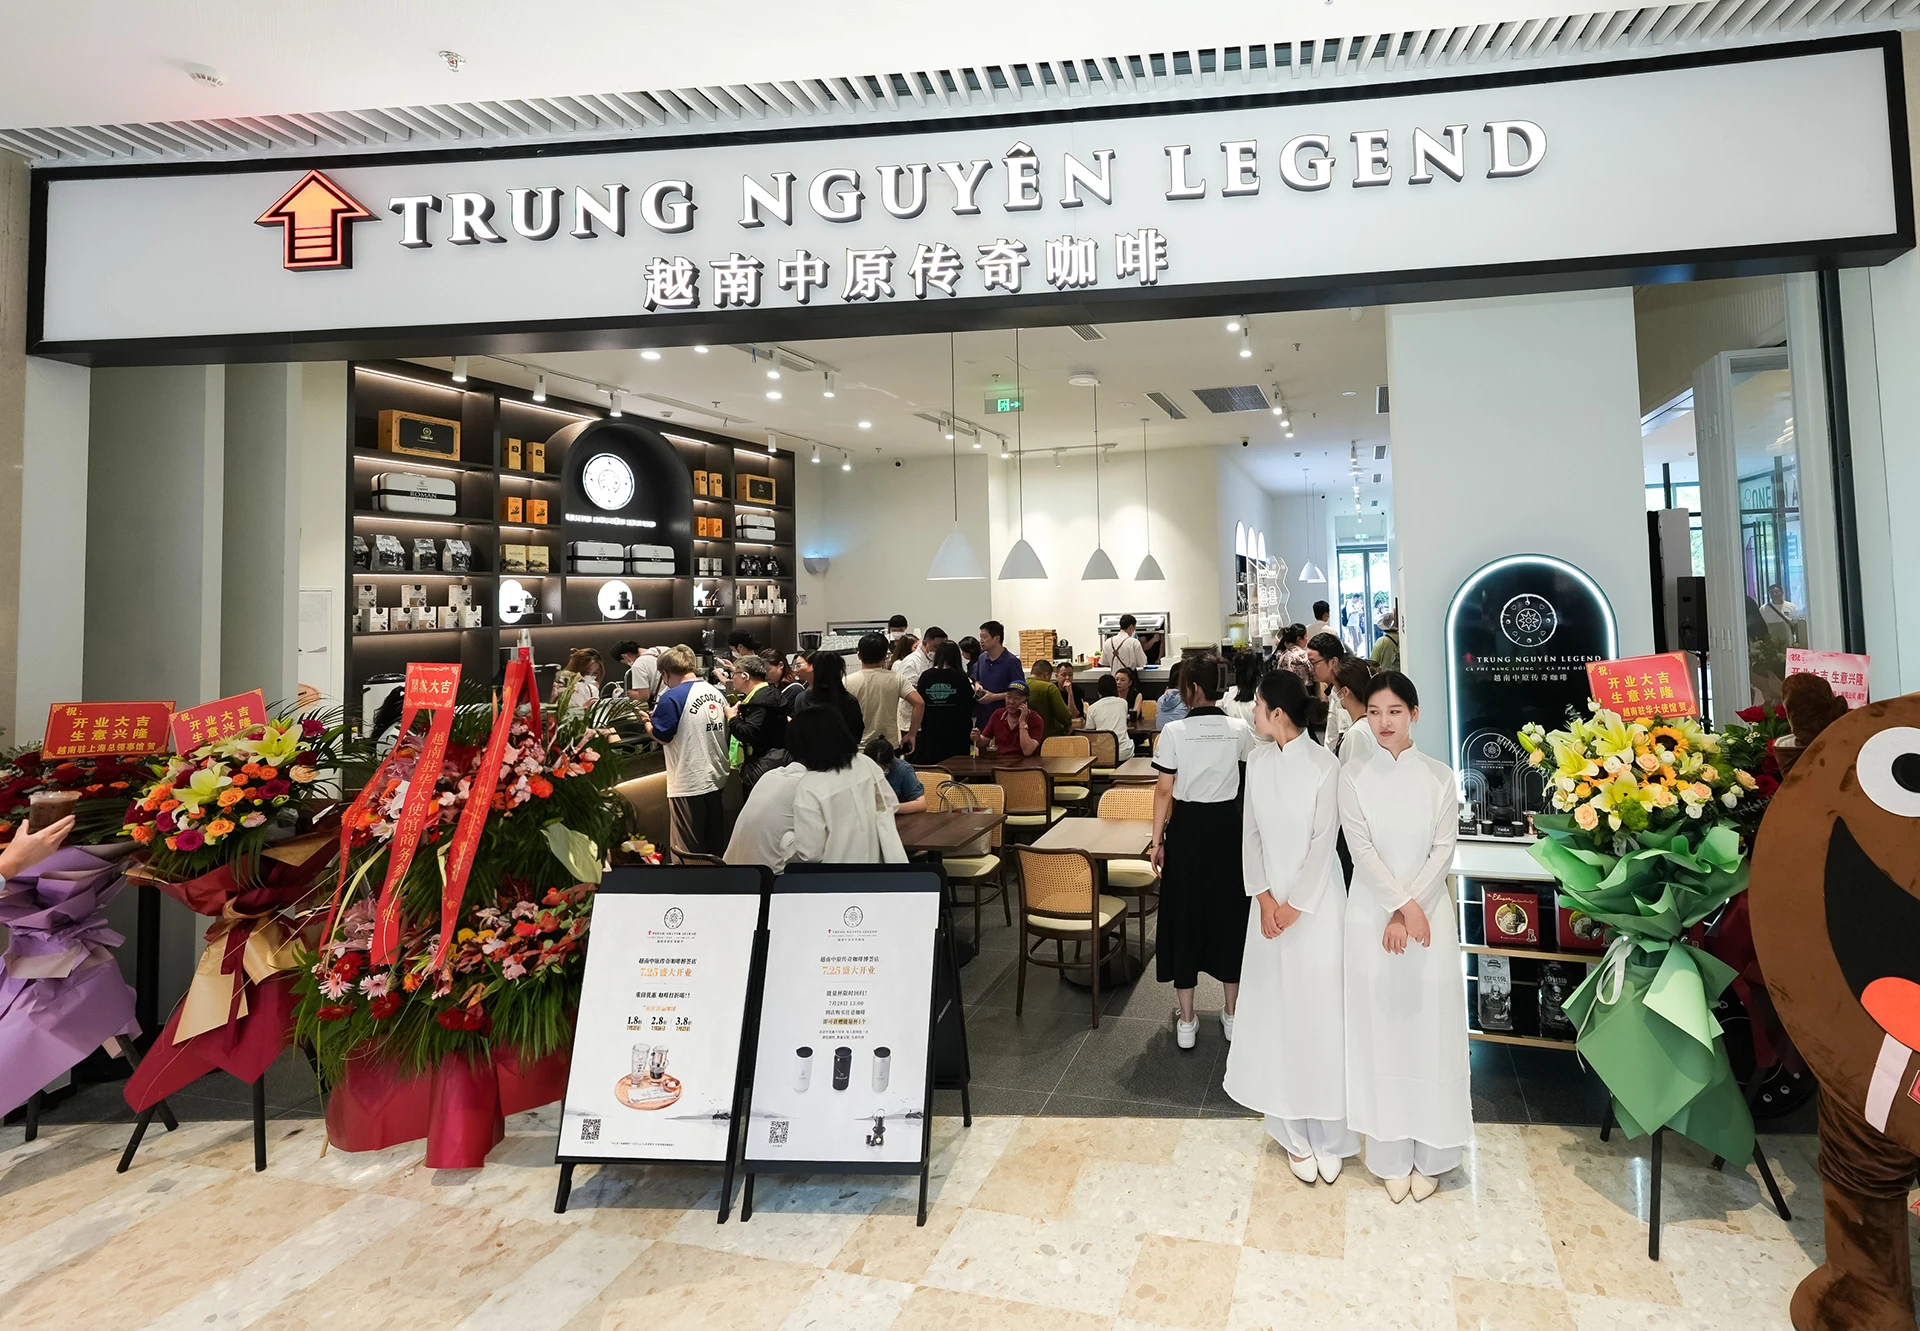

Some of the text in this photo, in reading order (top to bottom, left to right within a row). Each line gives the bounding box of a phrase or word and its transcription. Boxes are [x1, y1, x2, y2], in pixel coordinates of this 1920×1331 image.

[388, 119, 1548, 249] TRUNG NGUYÊN LEGEND
[643, 228, 1169, 312] 越南中原传奇咖啡
[1476, 655, 1511, 663] TRUNG
[1515, 653, 1557, 663] NGUYÊN
[1493, 673, 1568, 682] 越南中原传奇咖啡
[1608, 671, 1670, 689] 开业大吉
[1831, 671, 1864, 686] 生意兴隆
[1611, 686, 1674, 704] 生意兴隆
[1622, 701, 1687, 717] 越南驻华大使馆 贺
[73, 716, 151, 729] 开业大吉
[189, 706, 249, 731] 开业大吉
[70, 729, 148, 742] 生意兴隆
[192, 717, 252, 743] 生意兴隆
[56, 742, 156, 755] 越南驻上海总领事馆 贺
